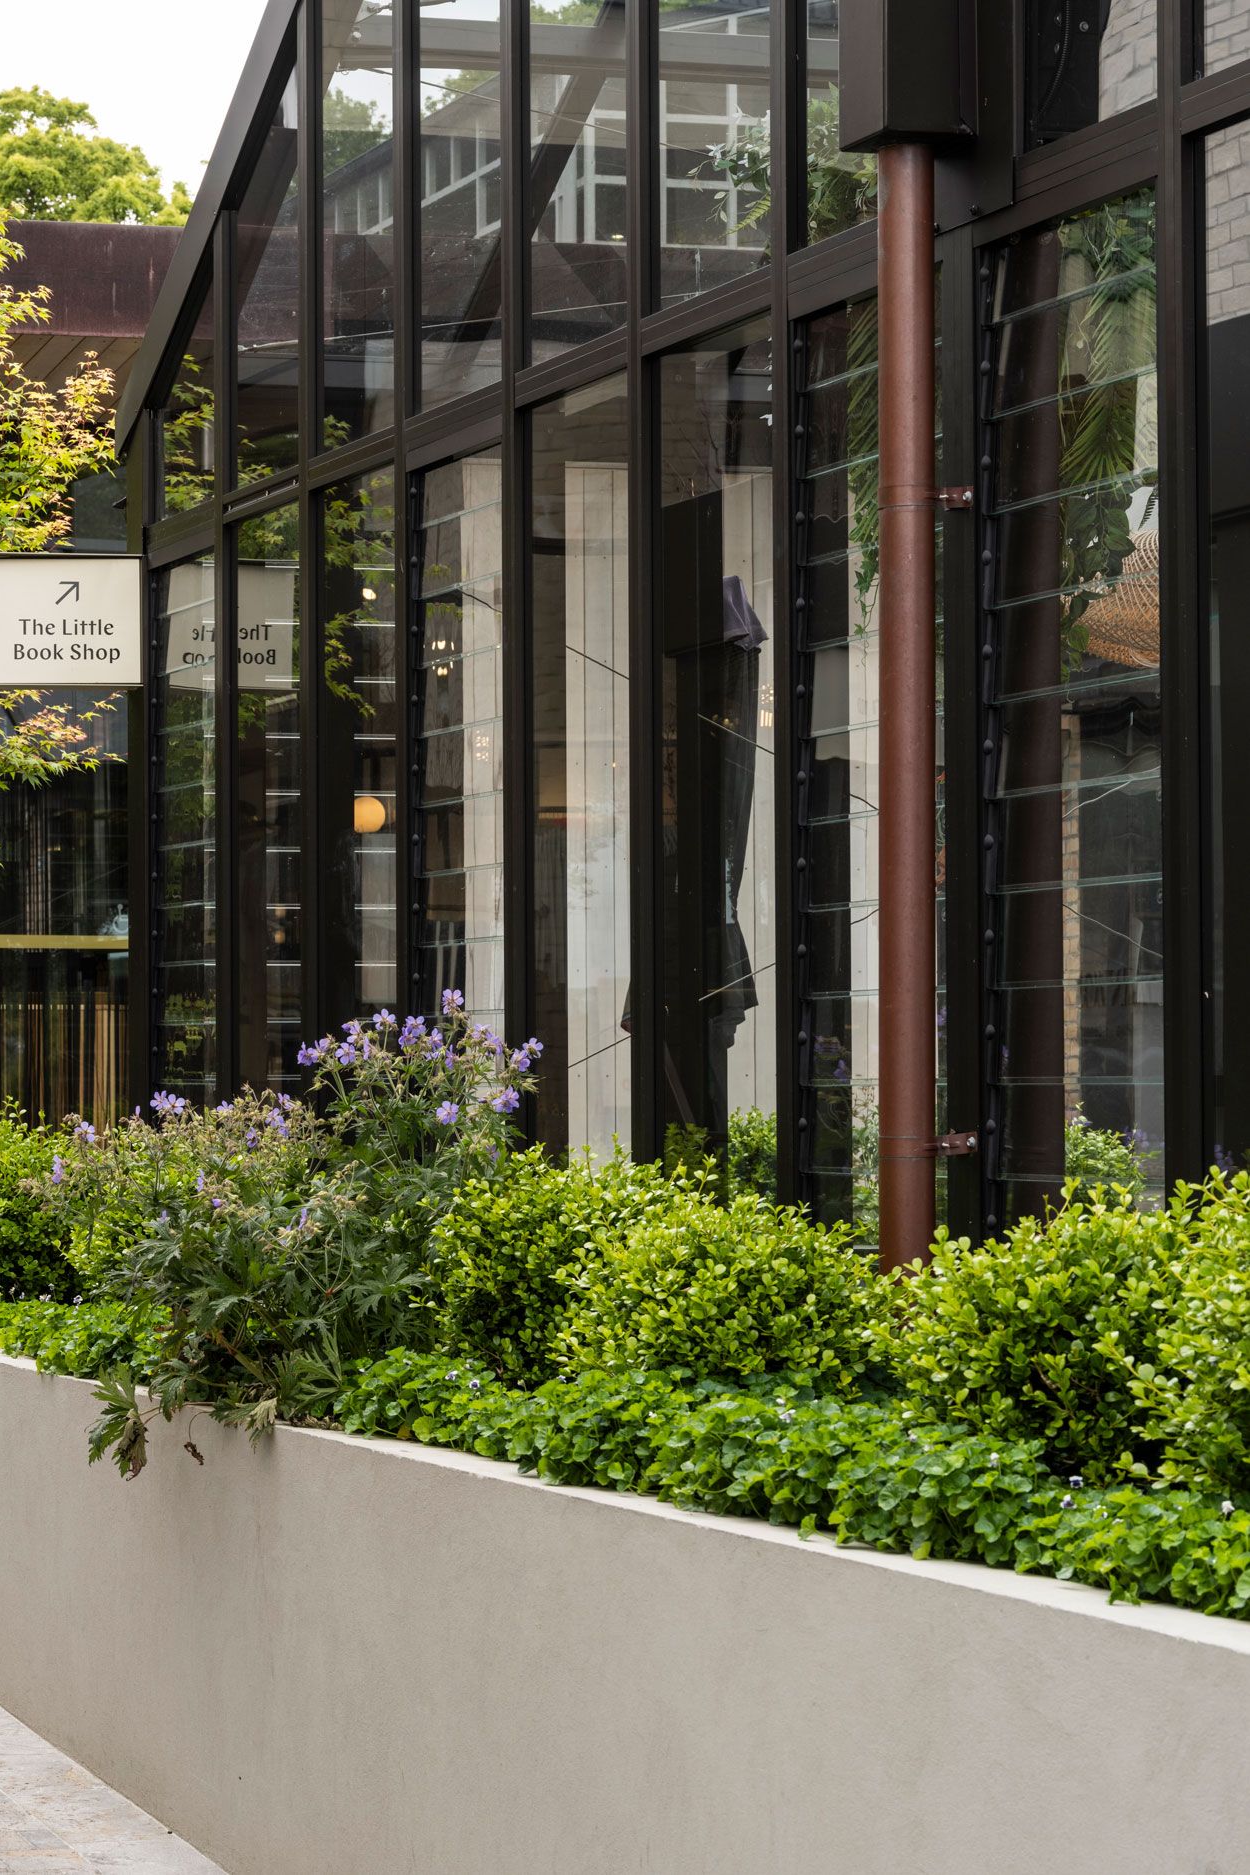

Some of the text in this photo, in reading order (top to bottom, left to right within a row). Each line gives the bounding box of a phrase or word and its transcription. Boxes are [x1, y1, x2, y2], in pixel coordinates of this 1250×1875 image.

[18, 618, 114, 636] The Little
[13, 643, 121, 664] Book Shop
